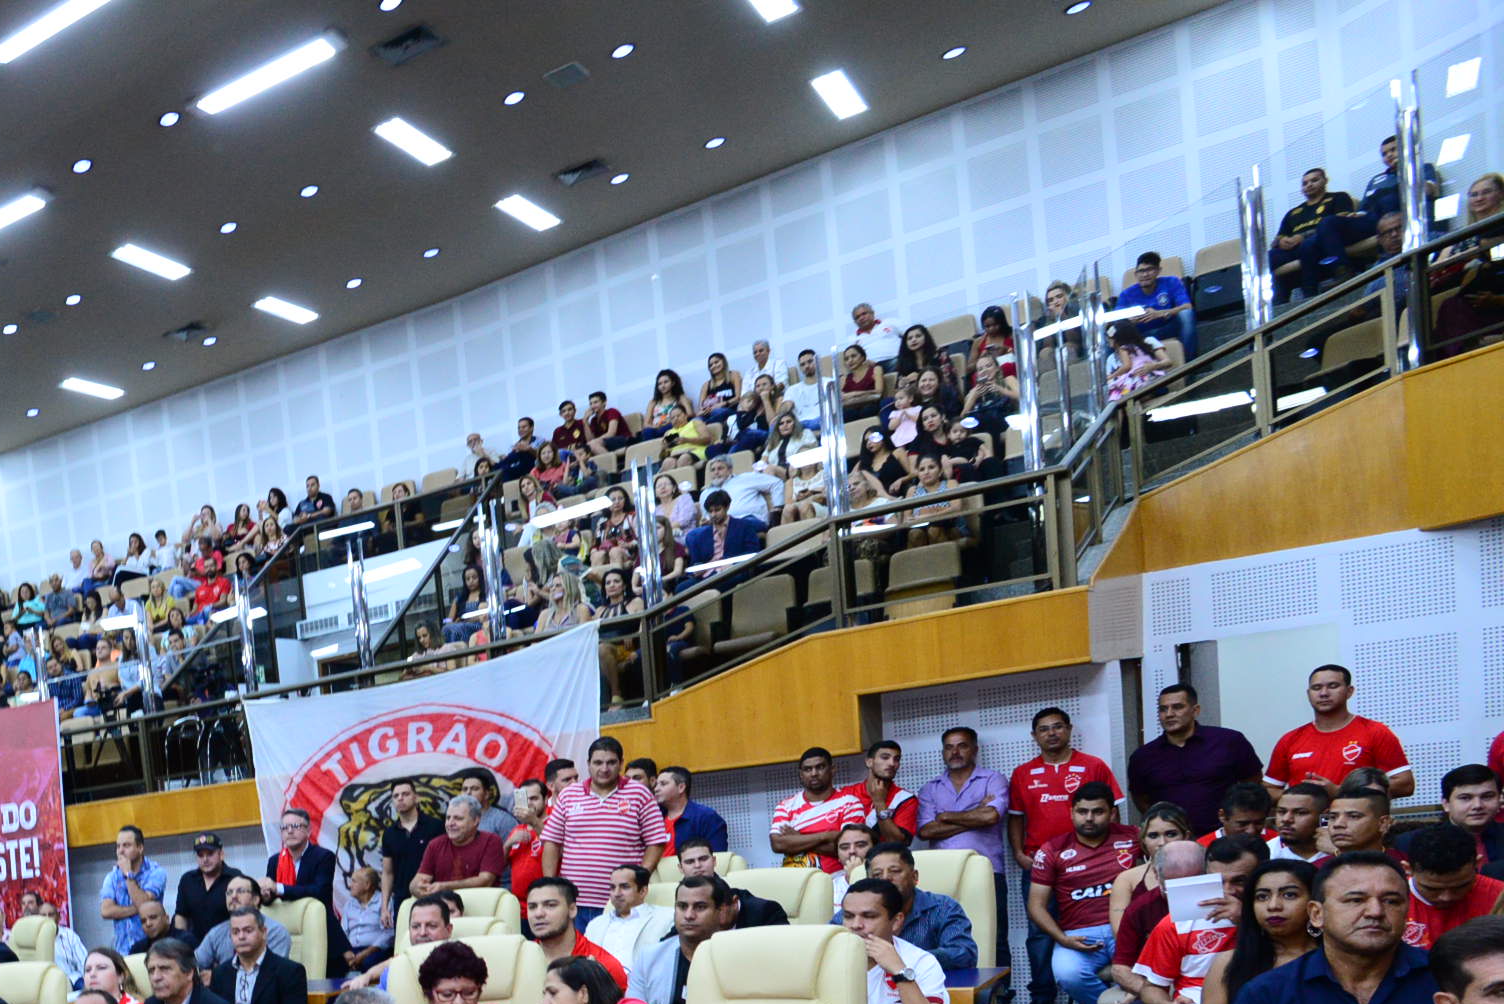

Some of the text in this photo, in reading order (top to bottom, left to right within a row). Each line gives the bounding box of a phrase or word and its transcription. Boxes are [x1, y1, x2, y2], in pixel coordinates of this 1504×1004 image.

[320, 715, 509, 785] TIGRÃO
[0, 800, 37, 834] DO
[1070, 882, 1113, 901] CAIX
